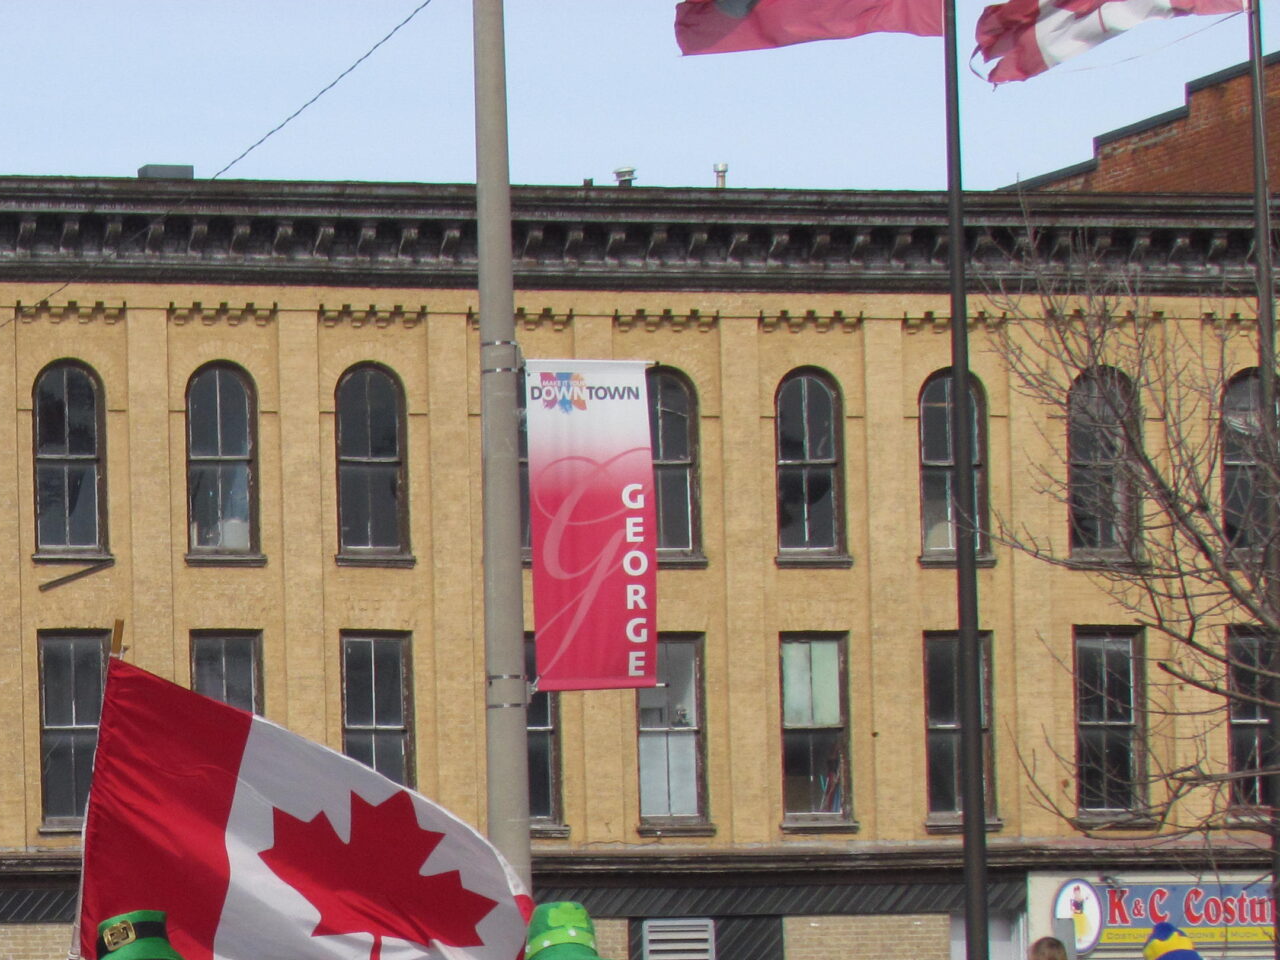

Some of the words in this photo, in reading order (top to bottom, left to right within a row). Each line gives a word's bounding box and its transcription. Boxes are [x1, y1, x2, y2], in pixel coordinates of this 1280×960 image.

[530, 386, 640, 401] DOWNTOWN
[621, 483, 649, 677] GEORGE
[1184, 888, 1275, 925] Costu
